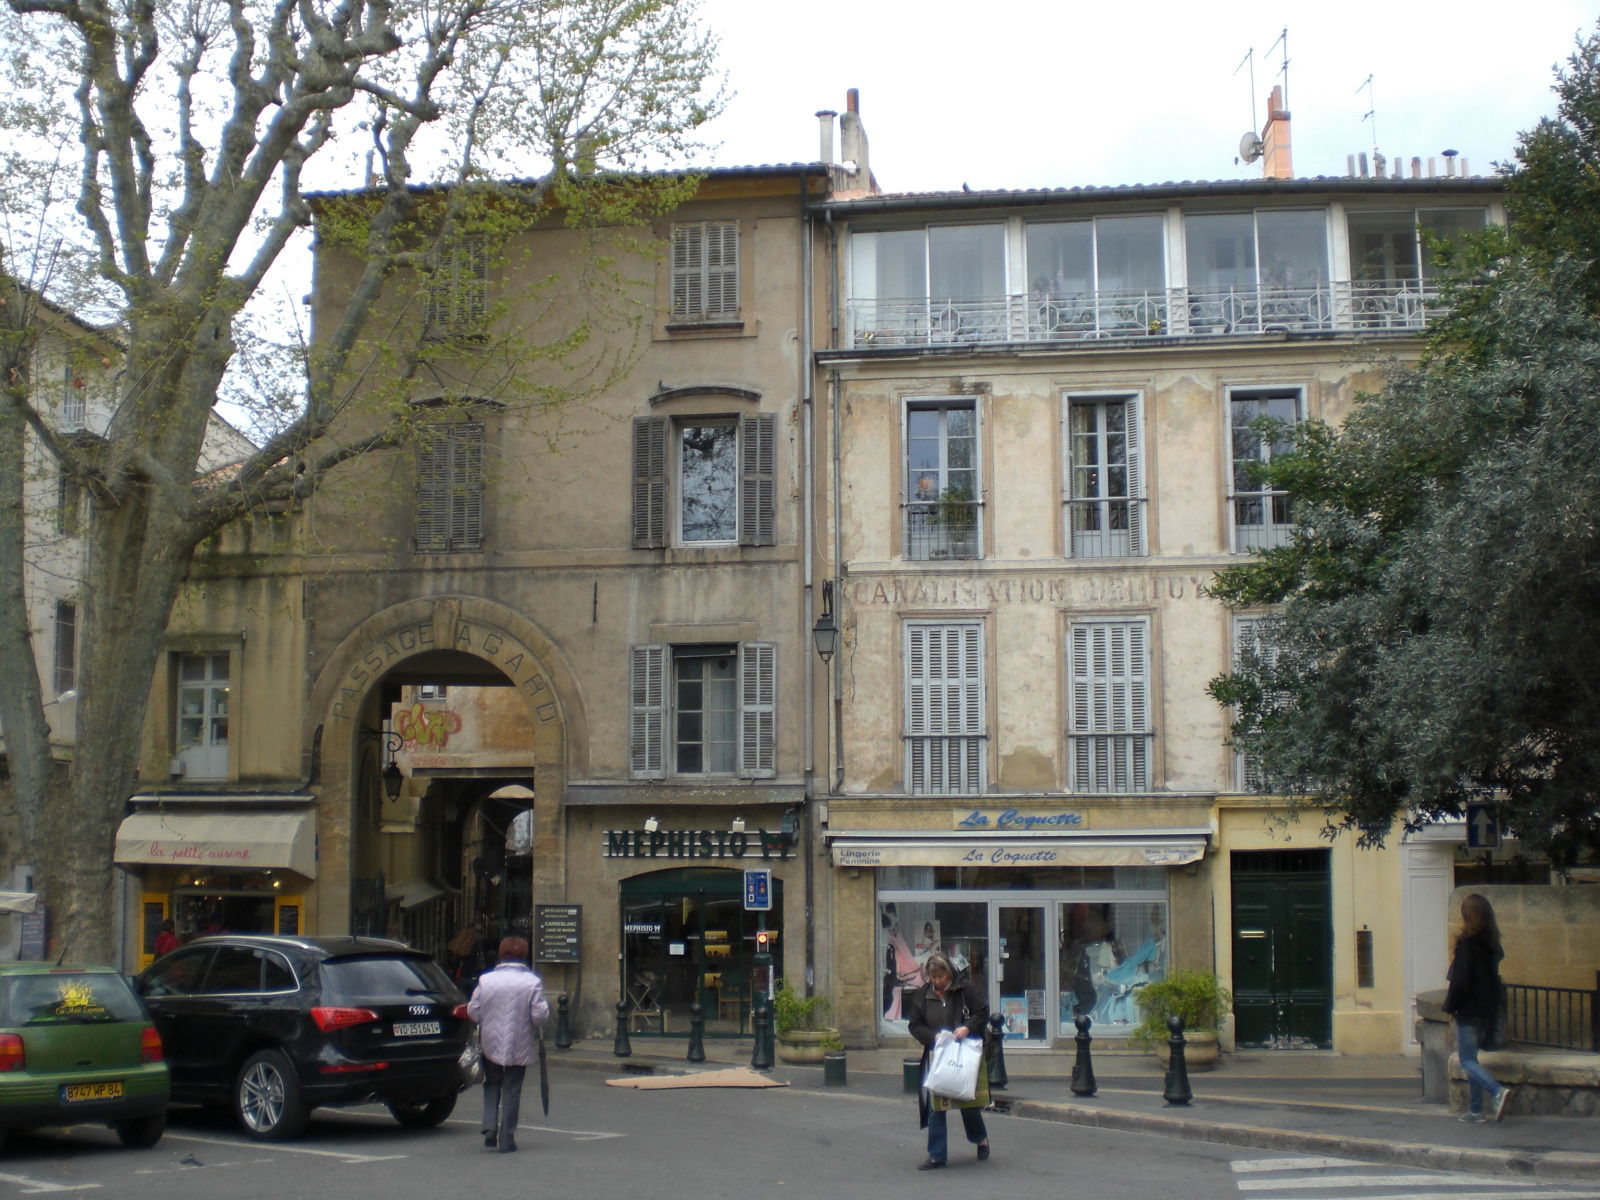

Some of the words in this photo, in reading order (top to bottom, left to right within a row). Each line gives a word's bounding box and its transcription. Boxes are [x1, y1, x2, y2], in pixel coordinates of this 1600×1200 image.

[332, 623, 434, 720] PASSAGE
[456, 624, 559, 723] AGARD
[959, 810, 990, 827] La
[996, 808, 1083, 830] Coquette
[149, 840, 164, 857] la
[170, 847, 203, 861] petite
[208, 848, 250, 860] cuisine
[607, 830, 748, 859] MEPHISTO
[840, 849, 881, 858] Lingerie
[962, 849, 985, 862] La
[991, 847, 1058, 865] Coquette
[624, 924, 653, 932] MEPHISTO
[107, 1081, 120, 1096] 84
